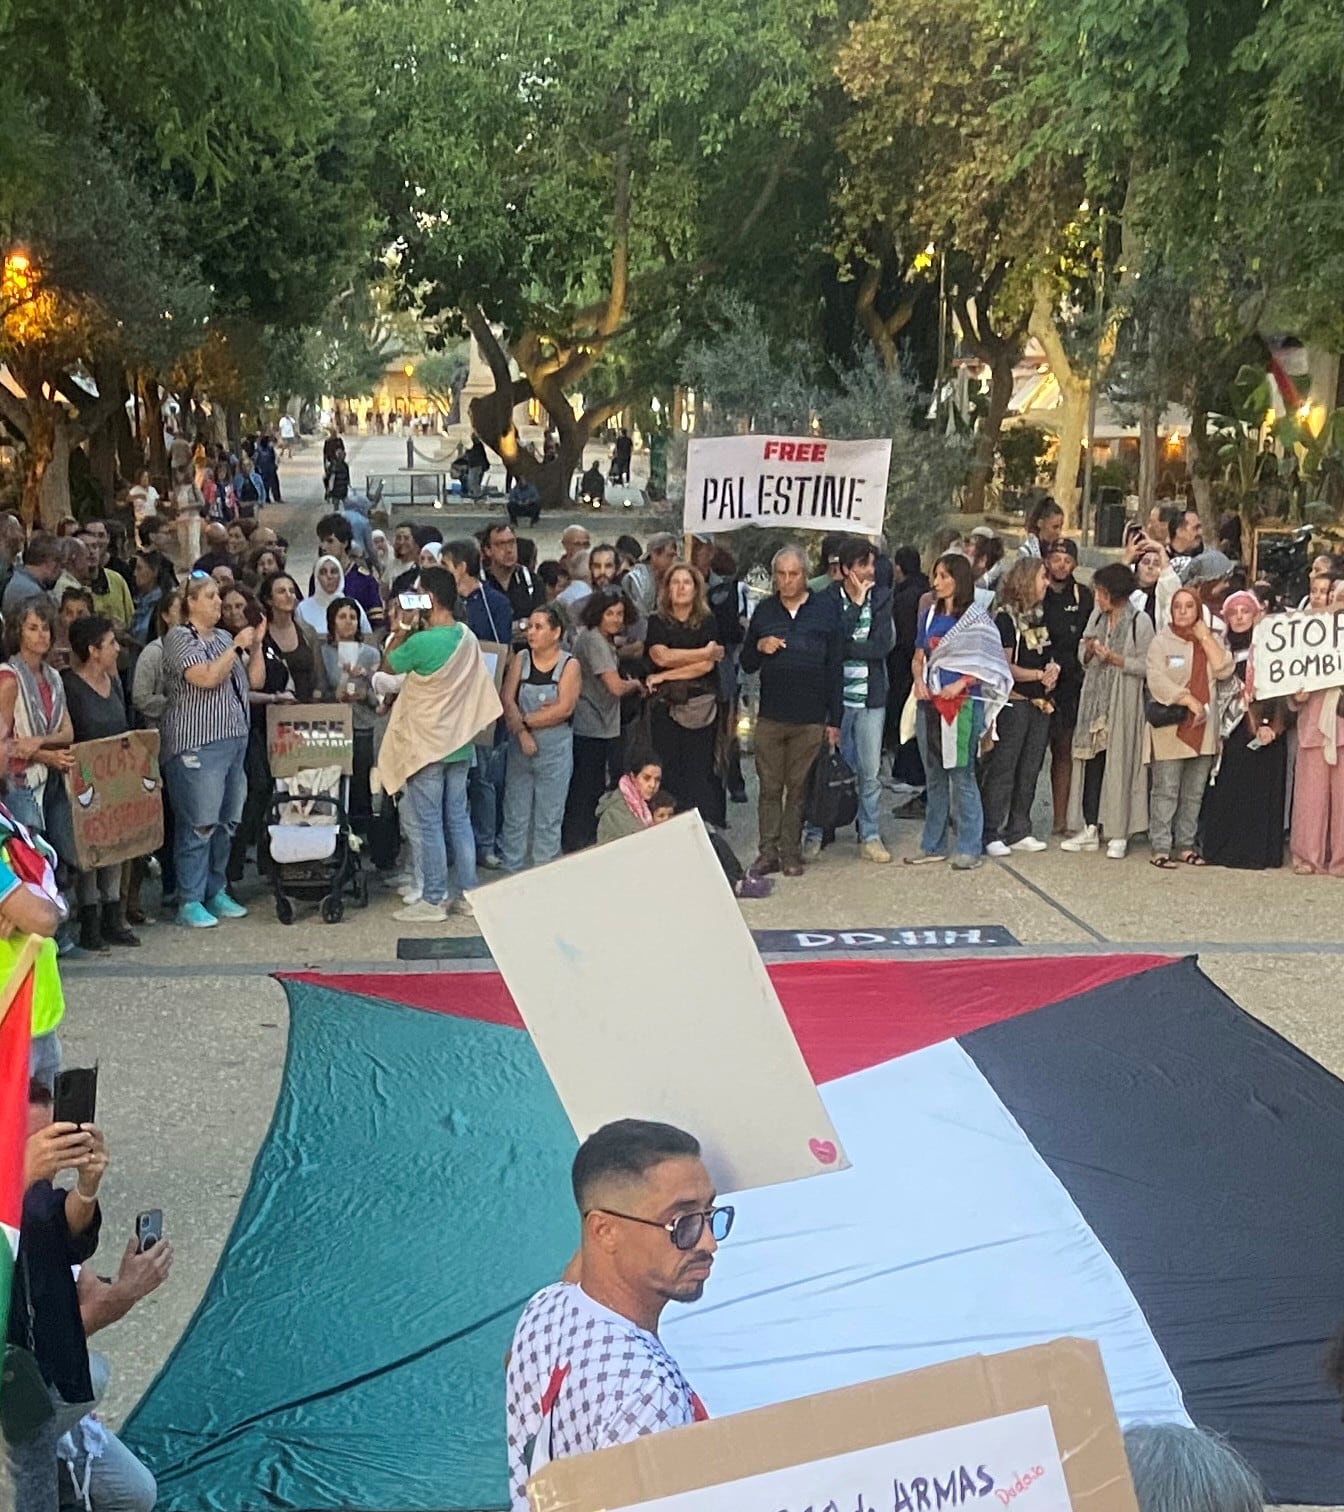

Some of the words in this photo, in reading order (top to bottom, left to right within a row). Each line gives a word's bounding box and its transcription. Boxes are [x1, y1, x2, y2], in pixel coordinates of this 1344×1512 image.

[763, 440, 827, 463] FREE
[702, 474, 866, 520] PALESTINE
[277, 720, 345, 739] FREE
[796, 929, 997, 947] DD.HH.
